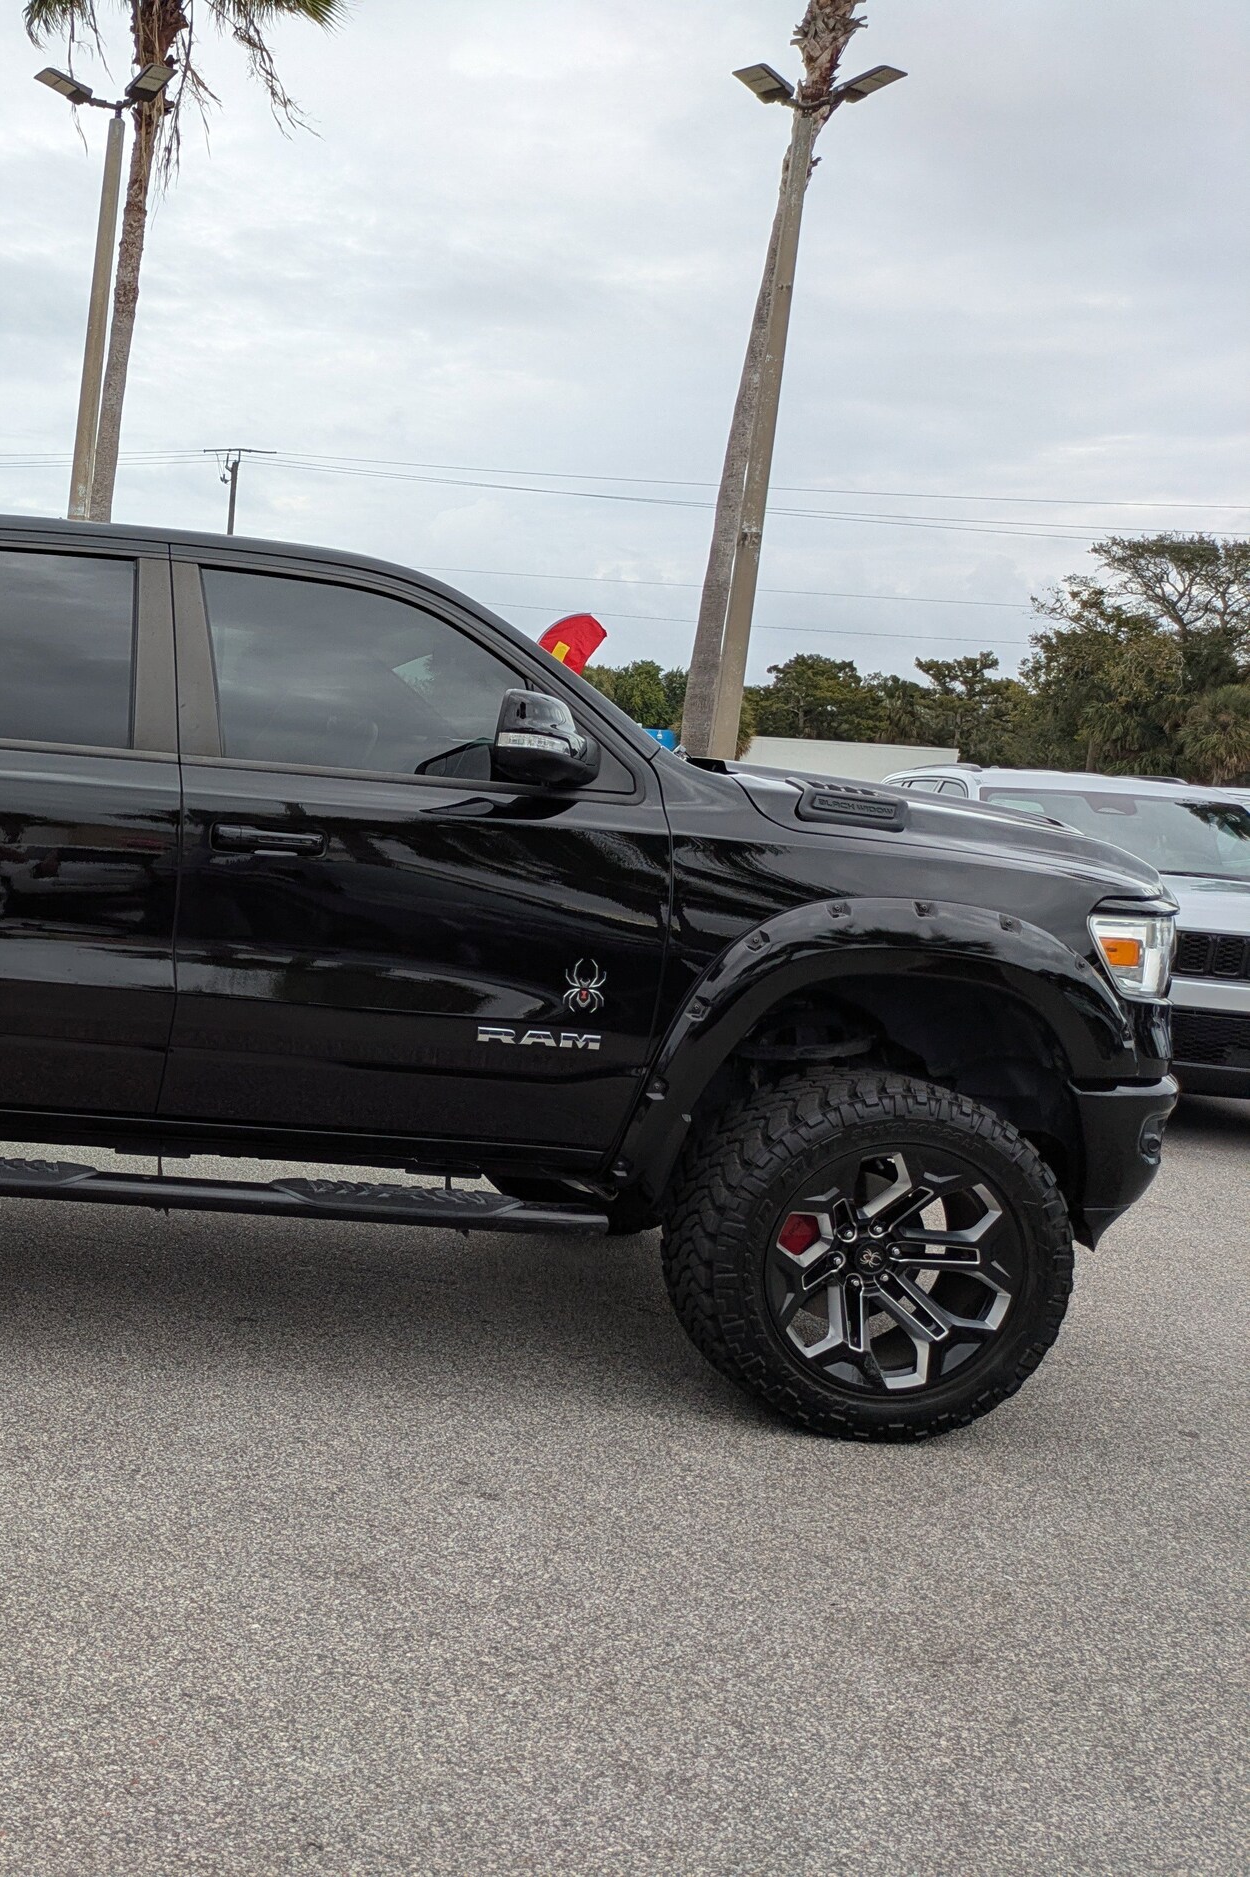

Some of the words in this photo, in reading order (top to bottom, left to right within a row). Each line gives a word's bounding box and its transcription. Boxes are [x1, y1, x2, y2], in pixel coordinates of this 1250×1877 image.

[817, 798, 855, 811] BLACK
[856, 804, 893, 815] WIDOW
[477, 1026, 601, 1050] RAM
